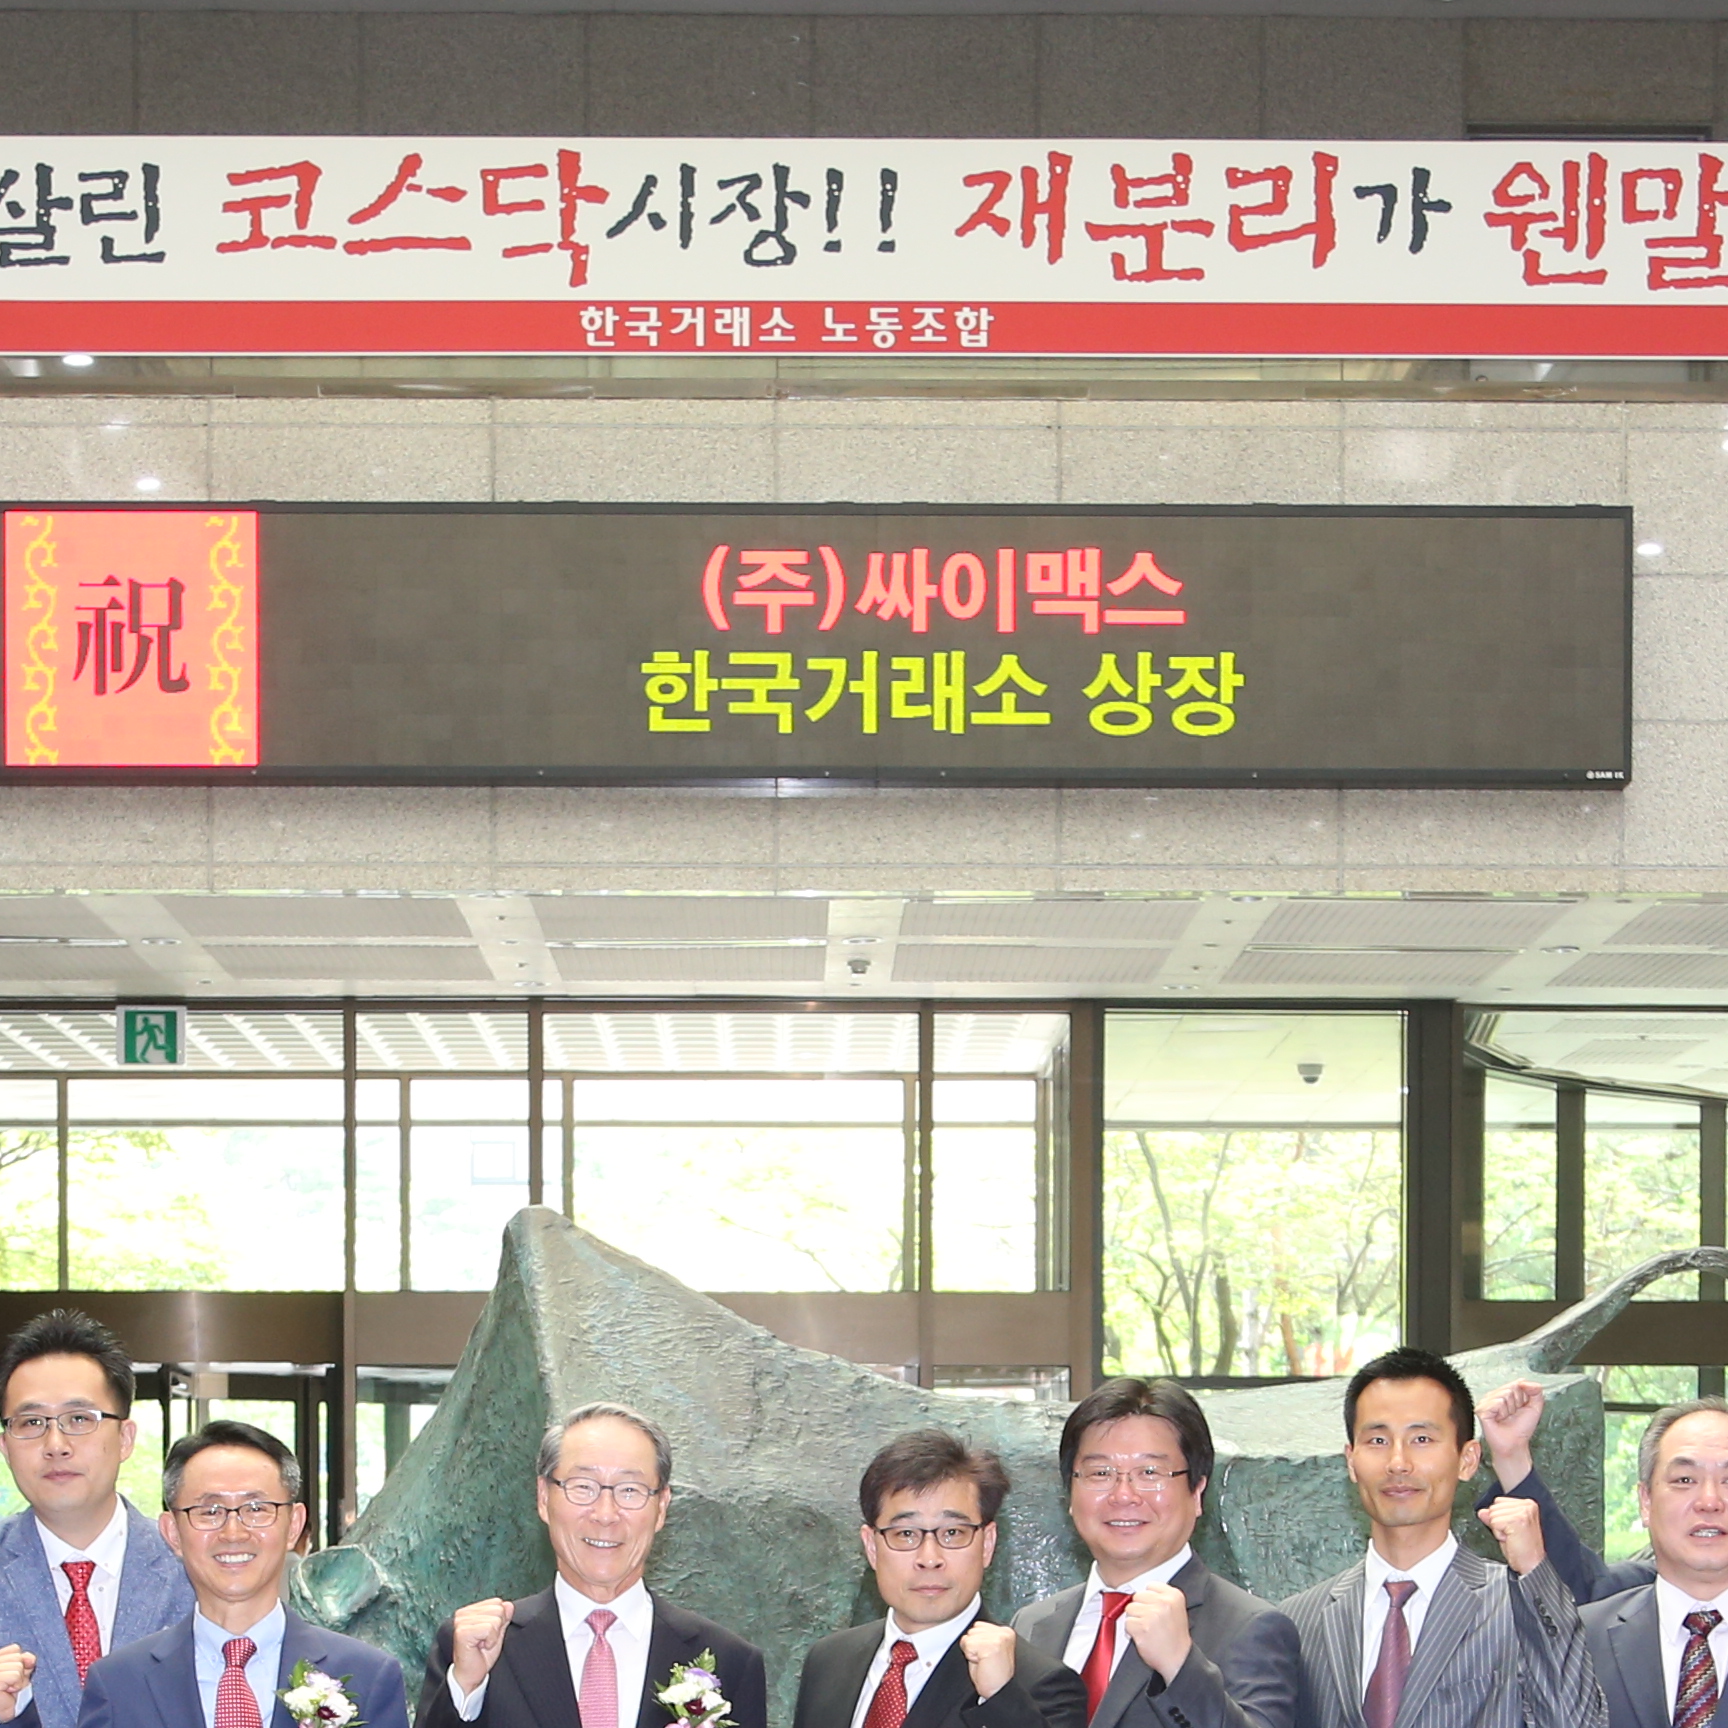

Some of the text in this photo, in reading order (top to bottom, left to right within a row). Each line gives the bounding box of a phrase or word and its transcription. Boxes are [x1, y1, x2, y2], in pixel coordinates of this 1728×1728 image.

[216, 148, 898, 288] 코스닥시장!!
[962, 151, 1451, 283] 재분리가
[579, 306, 995, 349] 한국거래소 노동조합
[701, 545, 1186, 635] (주)싸이맥스
[73, 575, 190, 696] 祝
[641, 649, 1245, 737] 한국거래소 상장
